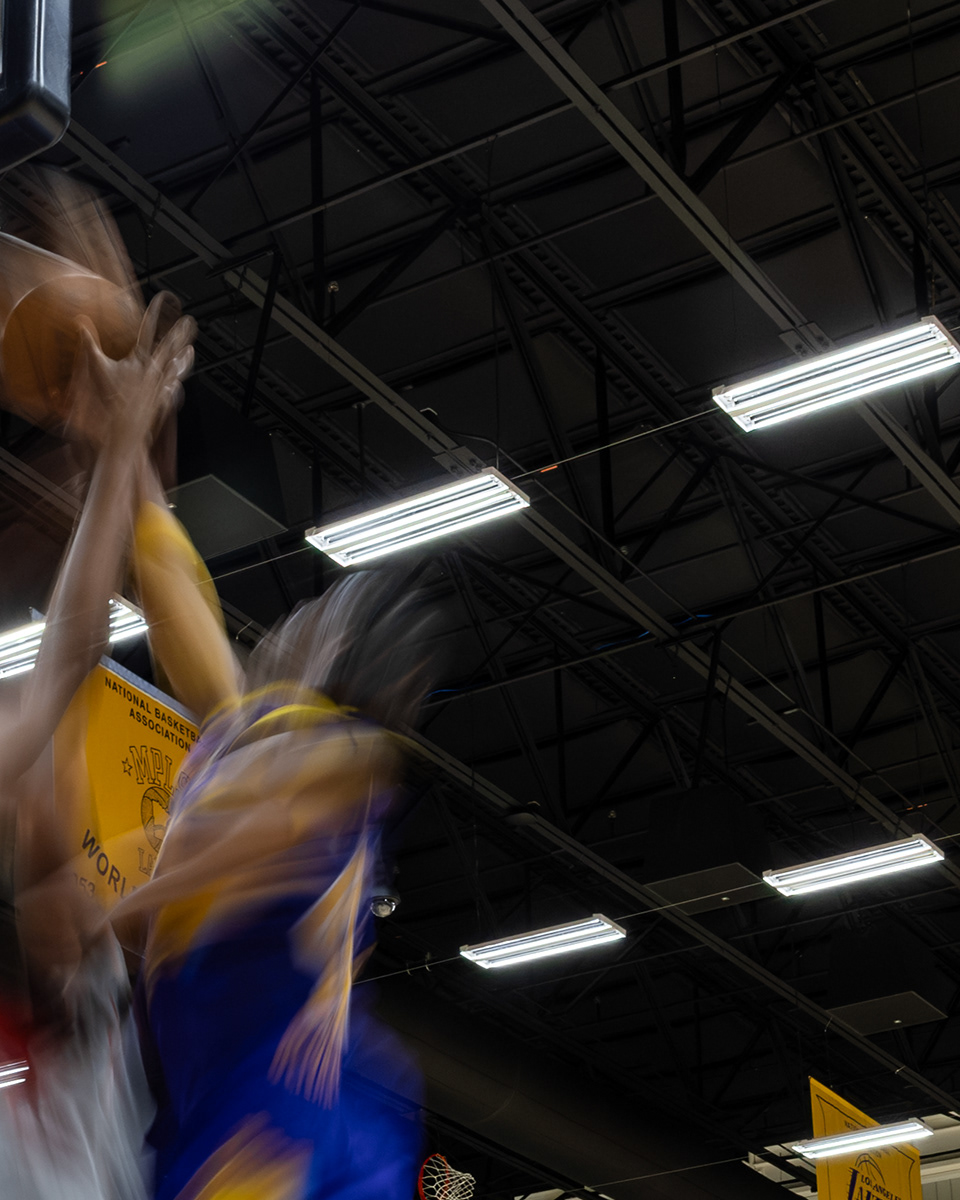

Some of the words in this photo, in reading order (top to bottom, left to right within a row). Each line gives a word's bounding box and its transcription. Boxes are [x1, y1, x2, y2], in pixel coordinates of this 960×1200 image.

[105, 676, 151, 715] NATIONAL
[129, 707, 190, 752] ASSOCIATION
[82, 828, 126, 899] WORL
